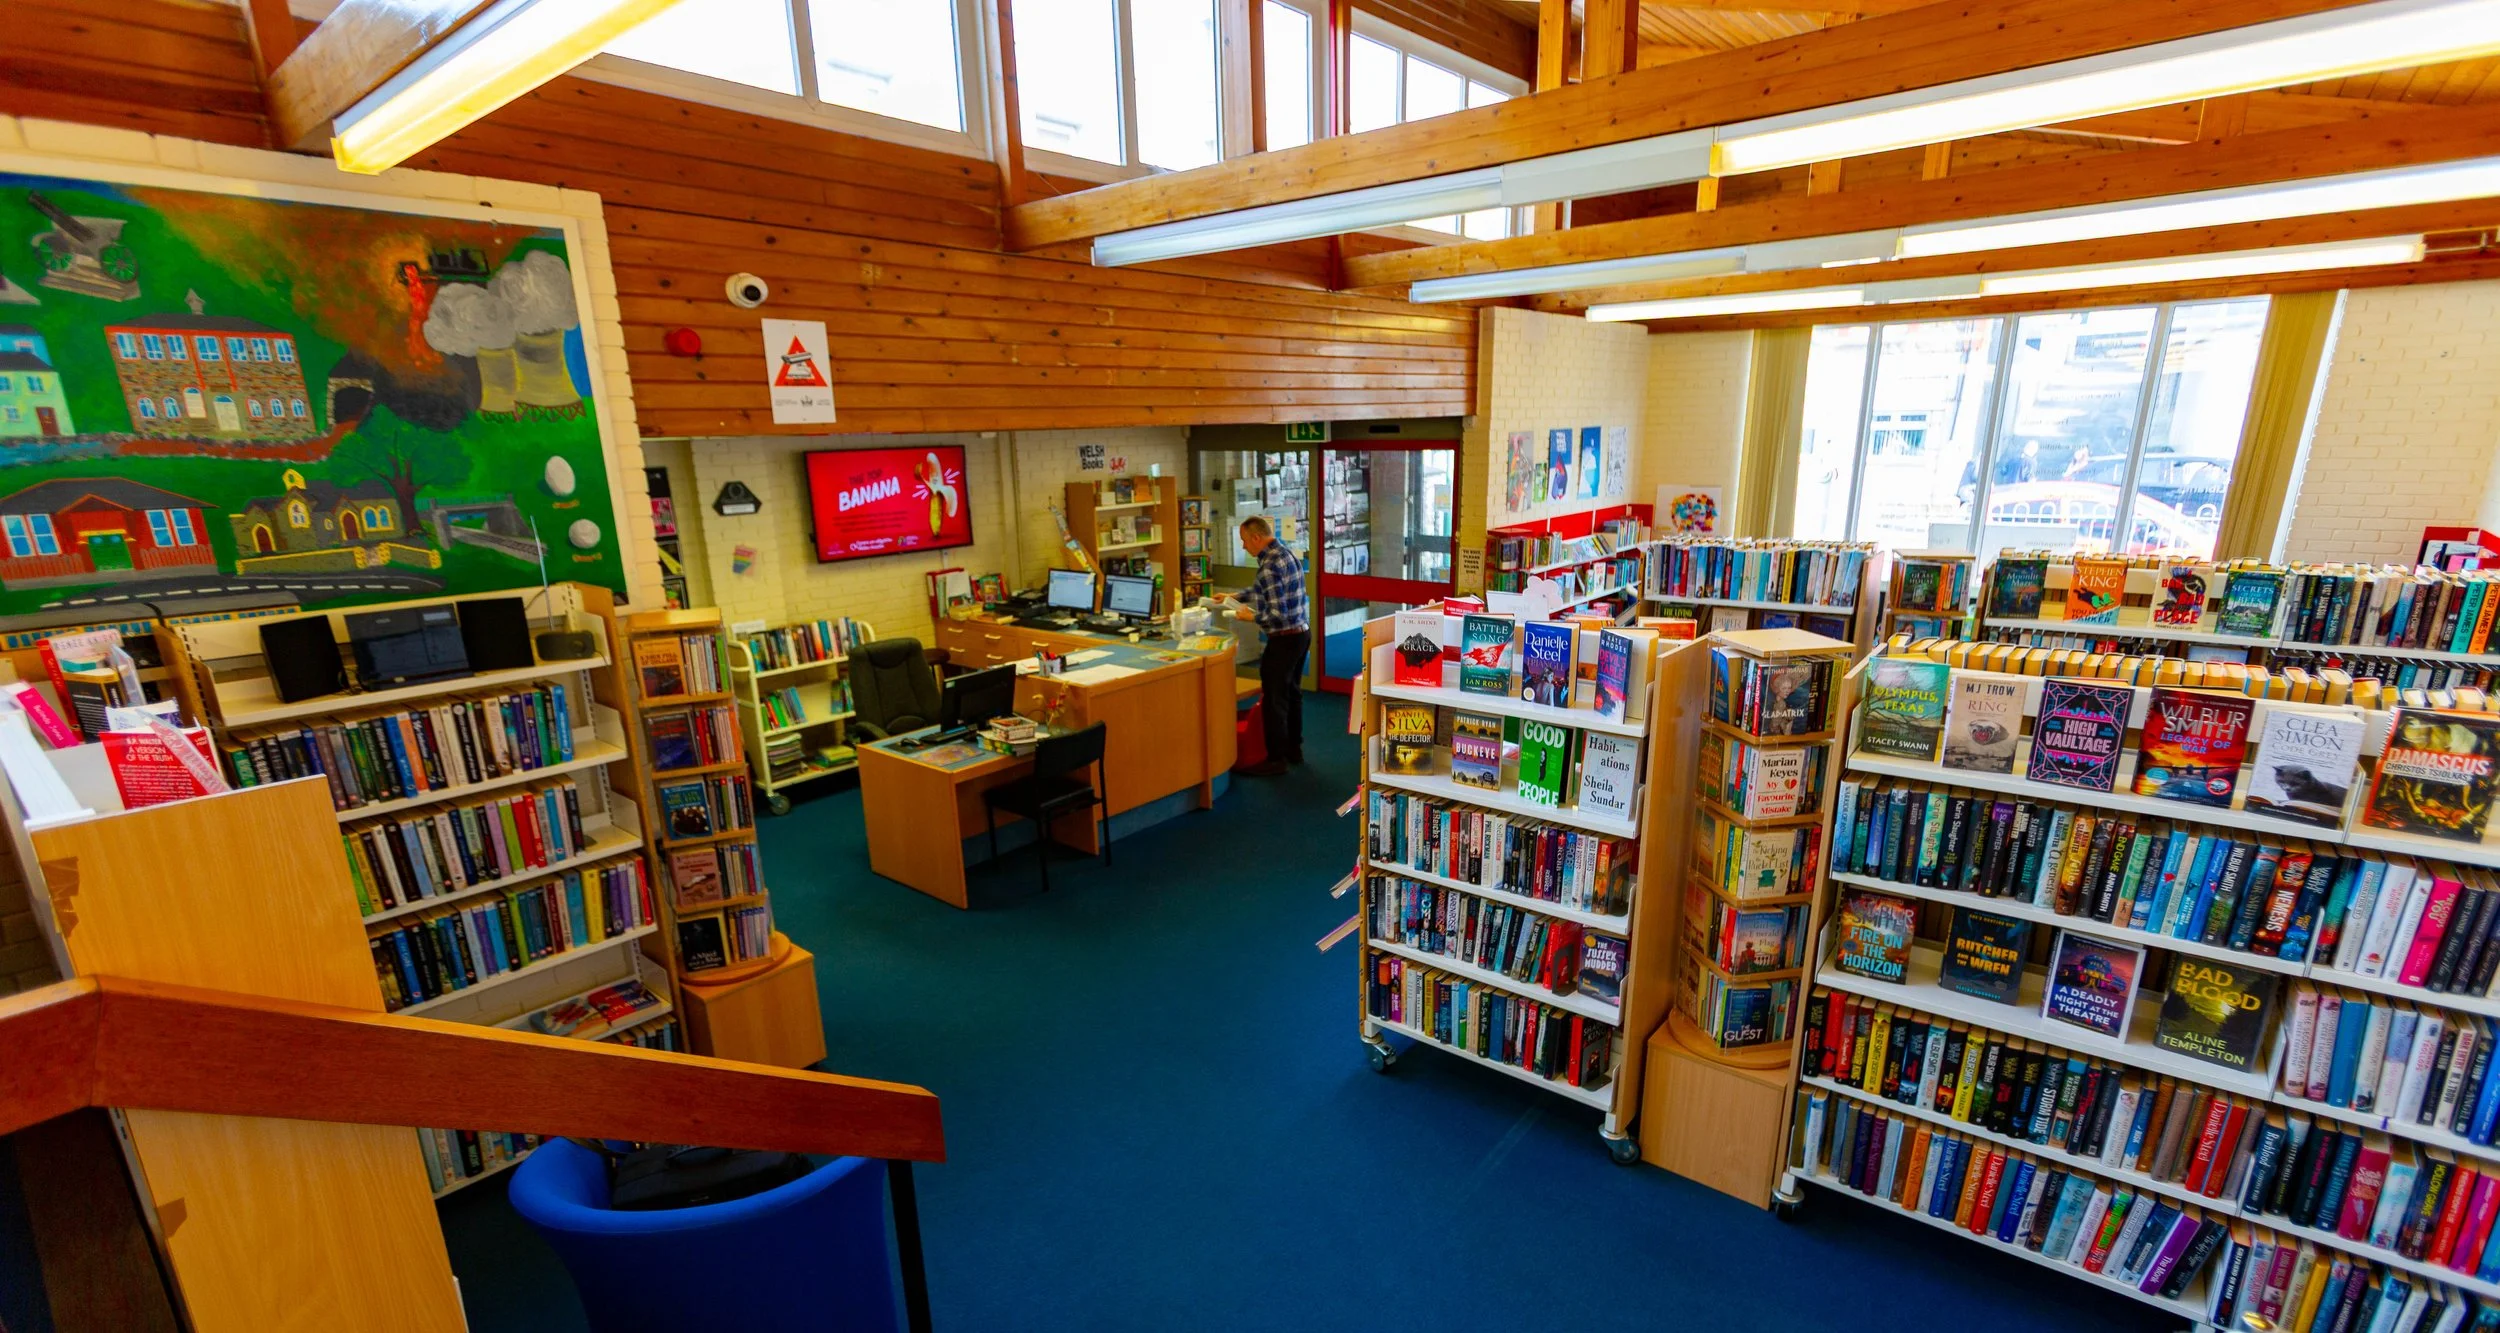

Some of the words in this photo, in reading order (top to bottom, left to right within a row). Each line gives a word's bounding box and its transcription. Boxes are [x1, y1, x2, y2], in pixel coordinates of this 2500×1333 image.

[1079, 445, 1105, 458] WELSH
[1082, 458, 1104, 470] Books
[838, 476, 901, 512] BANANA
[2076, 566, 2124, 578] STEPHEN
[2078, 575, 2118, 588] KING
[2231, 585, 2274, 594] SECRETS
[2467, 583, 2482, 608] PETER
[2486, 584, 2500, 608] PETER
[1469, 622, 1509, 635] BATTLE
[2461, 608, 2475, 634] JAMES
[2478, 608, 2493, 634] JAMES
[1403, 643, 1435, 652] GRACE
[1472, 632, 1505, 643] SONG
[1525, 631, 1568, 650] Danielle
[1601, 640, 1627, 654] RHODES
[1606, 635, 1622, 645] KATE
[1530, 643, 1561, 662] Steel
[1873, 686, 1939, 704] OLYMPUS,
[1987, 684, 2016, 696] TROW
[1885, 700, 1925, 714] TEXAS
[1968, 699, 2008, 713] RING
[2160, 702, 2246, 729] WILBUR
[1388, 718, 1433, 732] SILVA
[1456, 716, 1480, 726] PATRICK
[1482, 720, 1496, 728] RYAN
[2064, 718, 2098, 737] HIGH
[2163, 716, 2236, 740] SMITH
[2286, 718, 2338, 738] CLEA
[1389, 733, 1398, 741] THE
[1400, 734, 1431, 743] DEFECTOR
[1523, 720, 1565, 749] GOOD
[1866, 736, 1896, 747] STACEY
[1898, 739, 1930, 752] SWANN
[2045, 731, 2111, 754] VAULTAGE
[2160, 732, 2209, 747] LEGACY
[2212, 741, 2232, 750] OF
[2275, 730, 2344, 751] SIMON
[136, 746, 167, 754] VERSION
[1455, 742, 1496, 760] BUCKEYE
[1588, 736, 1620, 754] Habit-
[2180, 744, 2207, 754] WAR
[2271, 741, 2304, 755] CODE
[2307, 746, 2340, 760] GREY
[151, 754, 174, 762] TRUTH
[1600, 755, 1630, 772] ations
[1761, 757, 1798, 768] Marian
[2386, 747, 2490, 776] DAMASCUS
[1769, 769, 1798, 780] Keyes
[2384, 762, 2427, 775] CHRISTOS
[2429, 768, 2468, 780] TSIOLKAS
[1584, 774, 1614, 792] Sheila
[1766, 781, 1778, 792] My
[1517, 779, 1559, 809] PEOPLE
[1590, 790, 1625, 811] Sundar
[1757, 792, 1796, 803] Favourite
[1760, 805, 1792, 815] Mistake
[1932, 797, 1944, 819] Karin
[1953, 800, 1965, 820] Karin
[1432, 814, 1440, 838] Reichs
[1926, 822, 1940, 860] Slaughter
[1948, 820, 1960, 853] Slaughter
[2007, 842, 2020, 873] unseen
[2228, 847, 2245, 872] WILBUR
[2022, 853, 2034, 884] INDELIBLE
[2044, 862, 2058, 894] genesis
[2067, 858, 2082, 886] fallen
[2104, 872, 2116, 892] ANNA
[2220, 872, 2238, 892] SMITH
[2305, 867, 2323, 891] SMITH
[2100, 892, 2111, 912] SMITH
[2265, 890, 2295, 932] NEMESIS
[2428, 900, 2445, 920] YOU
[1850, 926, 1880, 944] FIRE
[1883, 934, 1904, 950] ON
[1862, 942, 1886, 960] THE
[1956, 938, 2019, 963] BUTCHER
[1843, 953, 1903, 978] HORIZON
[1970, 956, 2011, 976] WREN
[2180, 961, 2234, 987] BAD
[2054, 994, 2089, 1012] NIGHT
[2090, 1004, 2100, 1013] AT
[2102, 1009, 2120, 1018] THE
[2060, 986, 2069, 994] A
[2070, 988, 2118, 1008] DEADLY
[2176, 980, 2260, 1012] BLOOD
[2059, 1004, 2110, 1026] THEATRE
[2304, 1012, 2312, 1025] THE
[1723, 1028, 1764, 1042] GUEST
[2184, 1031, 2228, 1050] ALINE
[2460, 1032, 2473, 1050] DARK
[2161, 1034, 2246, 1066] TEMPLETON
[1928, 1058, 1938, 1075] SMITH
[1984, 1066, 1995, 1082] SMITH
[2062, 1076, 2074, 1103] REASONS
[2068, 1086, 2078, 1107] WICKED
[2442, 1086, 2458, 1104] TROW
[2038, 1088, 2057, 1117] STORM
[2460, 1092, 2476, 1120] ANGEL
[2034, 1116, 2050, 1134] TIDE
[2205, 1102, 2228, 1139] Danielle
[1942, 1141, 1958, 1172] Danielle
[2198, 1140, 2216, 1162] Steel
[2259, 1132, 2280, 1168] Rawblood
[1971, 1150, 1988, 1180] Danielle
[1986, 1156, 2004, 1188] Danielle
[1936, 1172, 1950, 1192] Steel
[2018, 1164, 2034, 1196] Danielle
[2426, 1164, 2446, 1192] HOLLOW
[1966, 1182, 1979, 1201] Steel
[1980, 1188, 1994, 1208] Steel
[2008, 1196, 2024, 1216] Steel
[2420, 1193, 2438, 1217] GRAVE
[2161, 1256, 2174, 1268] The
[2230, 1248, 2244, 1276] GIRLFRIEND
[2150, 1268, 2166, 1284] Monk
